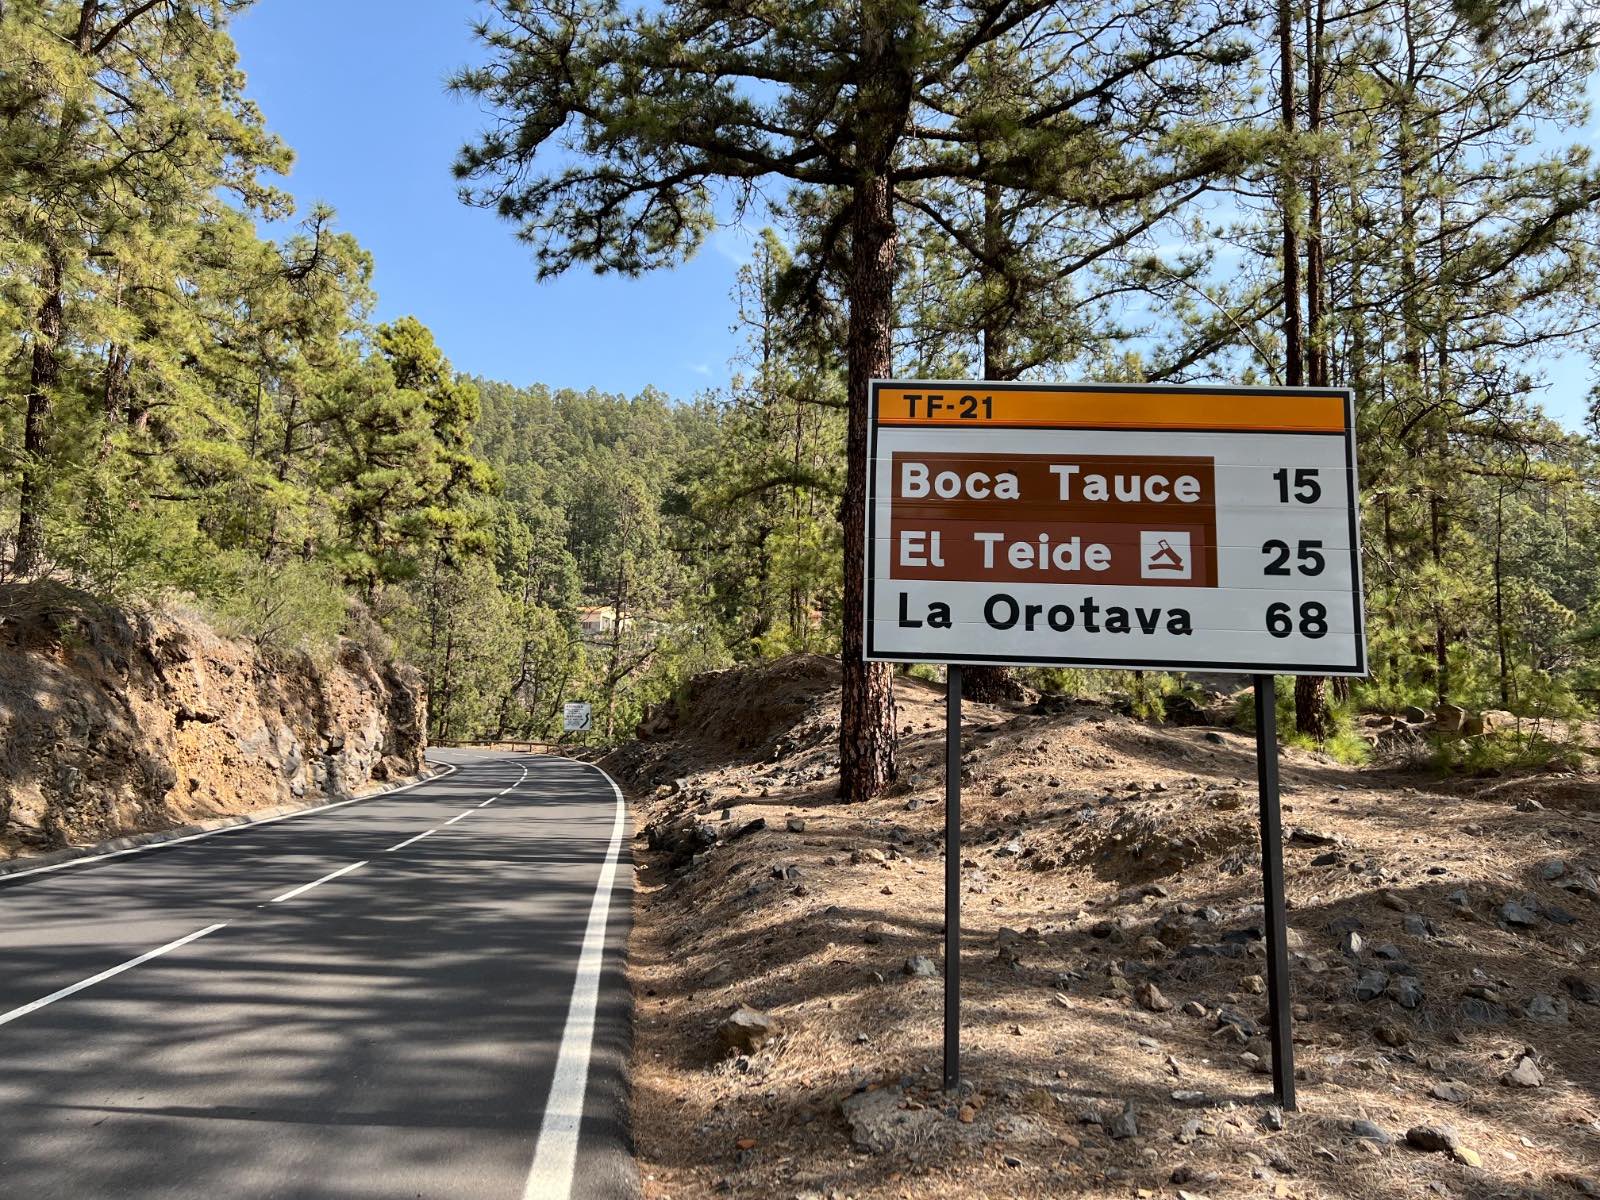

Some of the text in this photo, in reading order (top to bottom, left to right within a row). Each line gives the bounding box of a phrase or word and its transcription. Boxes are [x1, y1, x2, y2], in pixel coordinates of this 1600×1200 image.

[904, 394, 993, 419] TF-21
[901, 462, 1322, 504] Boca Tauce 15
[900, 531, 1325, 576] El Teide 25
[899, 592, 1328, 639] La Orotava 68
